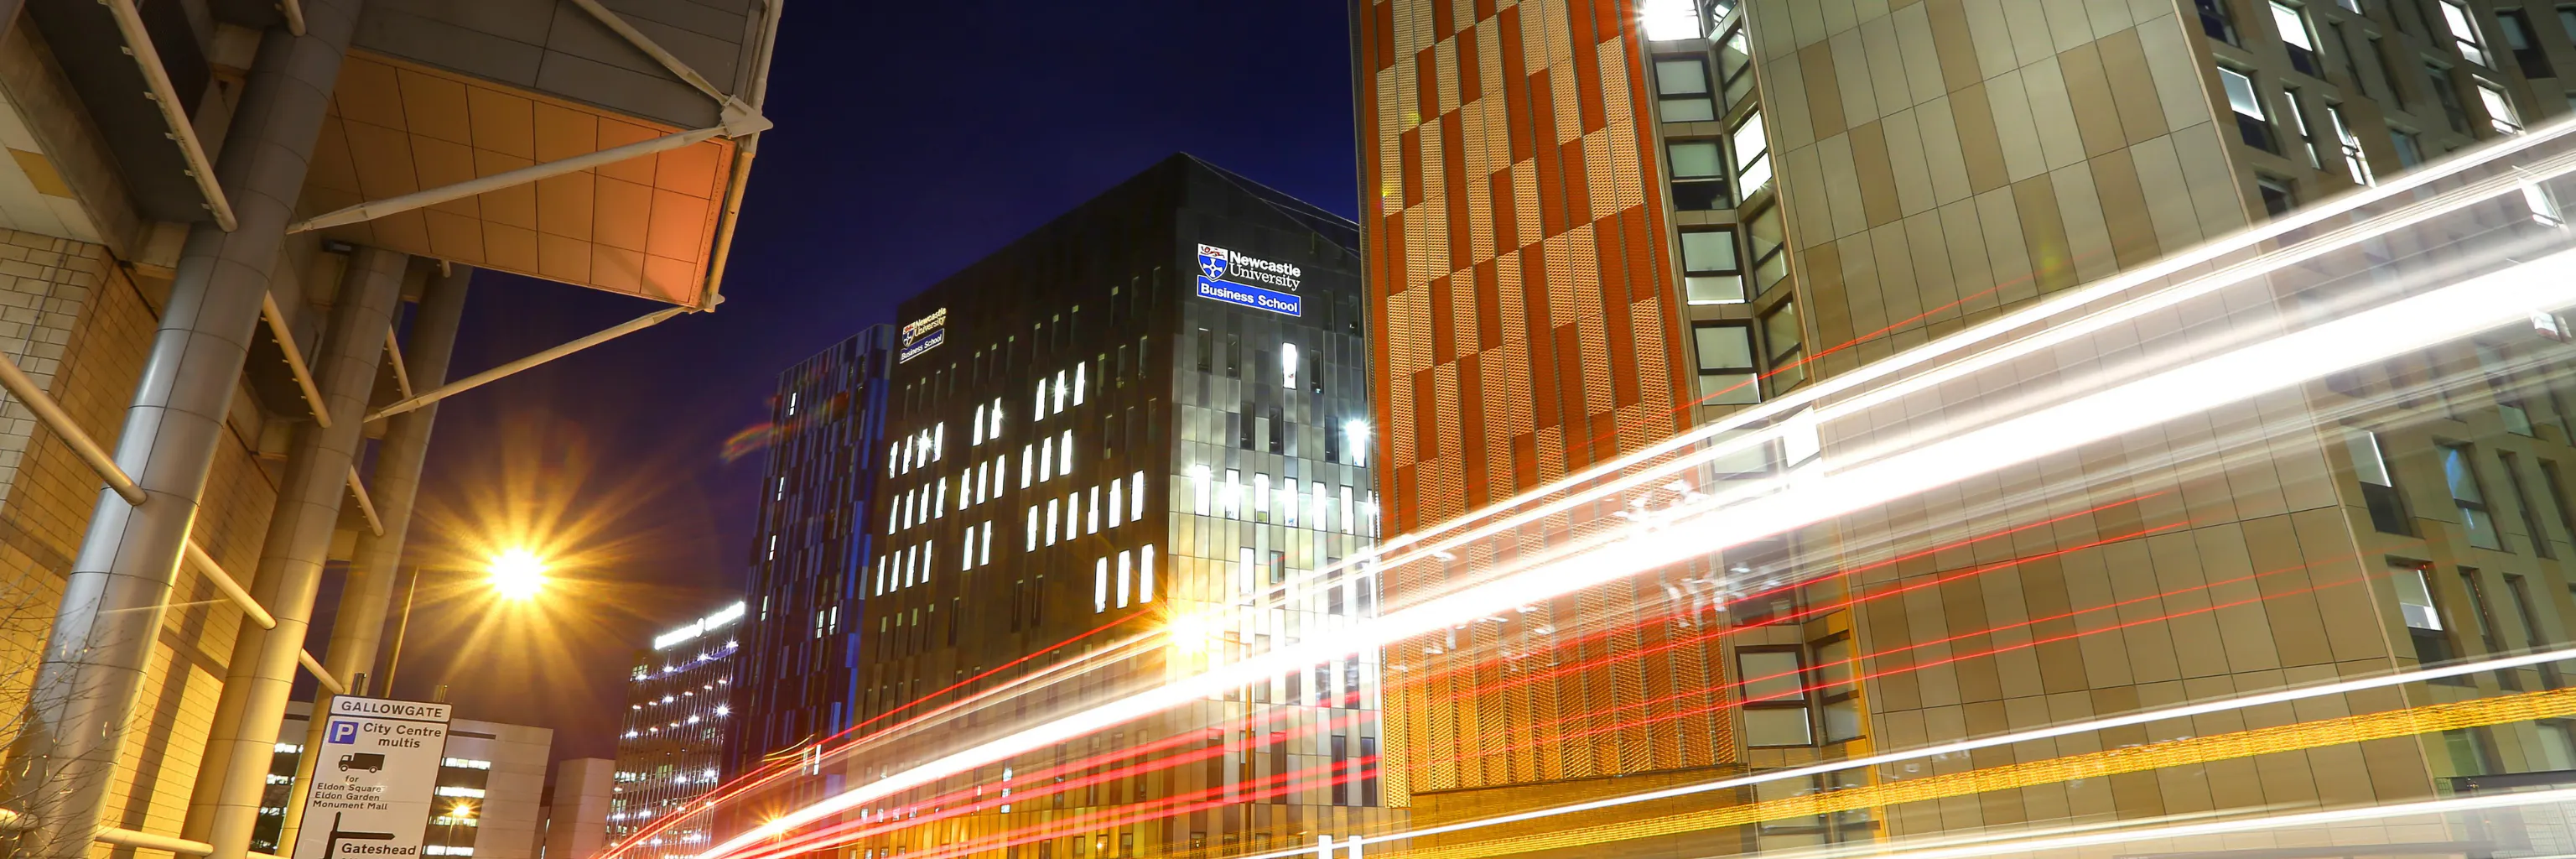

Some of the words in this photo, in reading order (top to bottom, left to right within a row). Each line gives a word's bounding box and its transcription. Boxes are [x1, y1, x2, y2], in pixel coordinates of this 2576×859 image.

[1229, 251, 1301, 277] Newcastle
[1229, 263, 1301, 291] University
[1201, 283, 1254, 303] Business
[1258, 295, 1297, 312] School
[914, 308, 946, 328] Newcastle
[914, 316, 946, 336] University
[901, 345, 923, 360] Business
[924, 334, 942, 348] School
[341, 700, 443, 718] GALLOWGATE
[335, 724, 354, 742] P
[363, 722, 391, 736] City
[396, 726, 442, 737] Centre
[378, 737, 420, 748] multis
[317, 783, 345, 791] Eldon
[348, 784, 382, 793] Square
[346, 793, 380, 801] Garden
[313, 800, 364, 809] Monument
[341, 843, 417, 855] Gateshead
